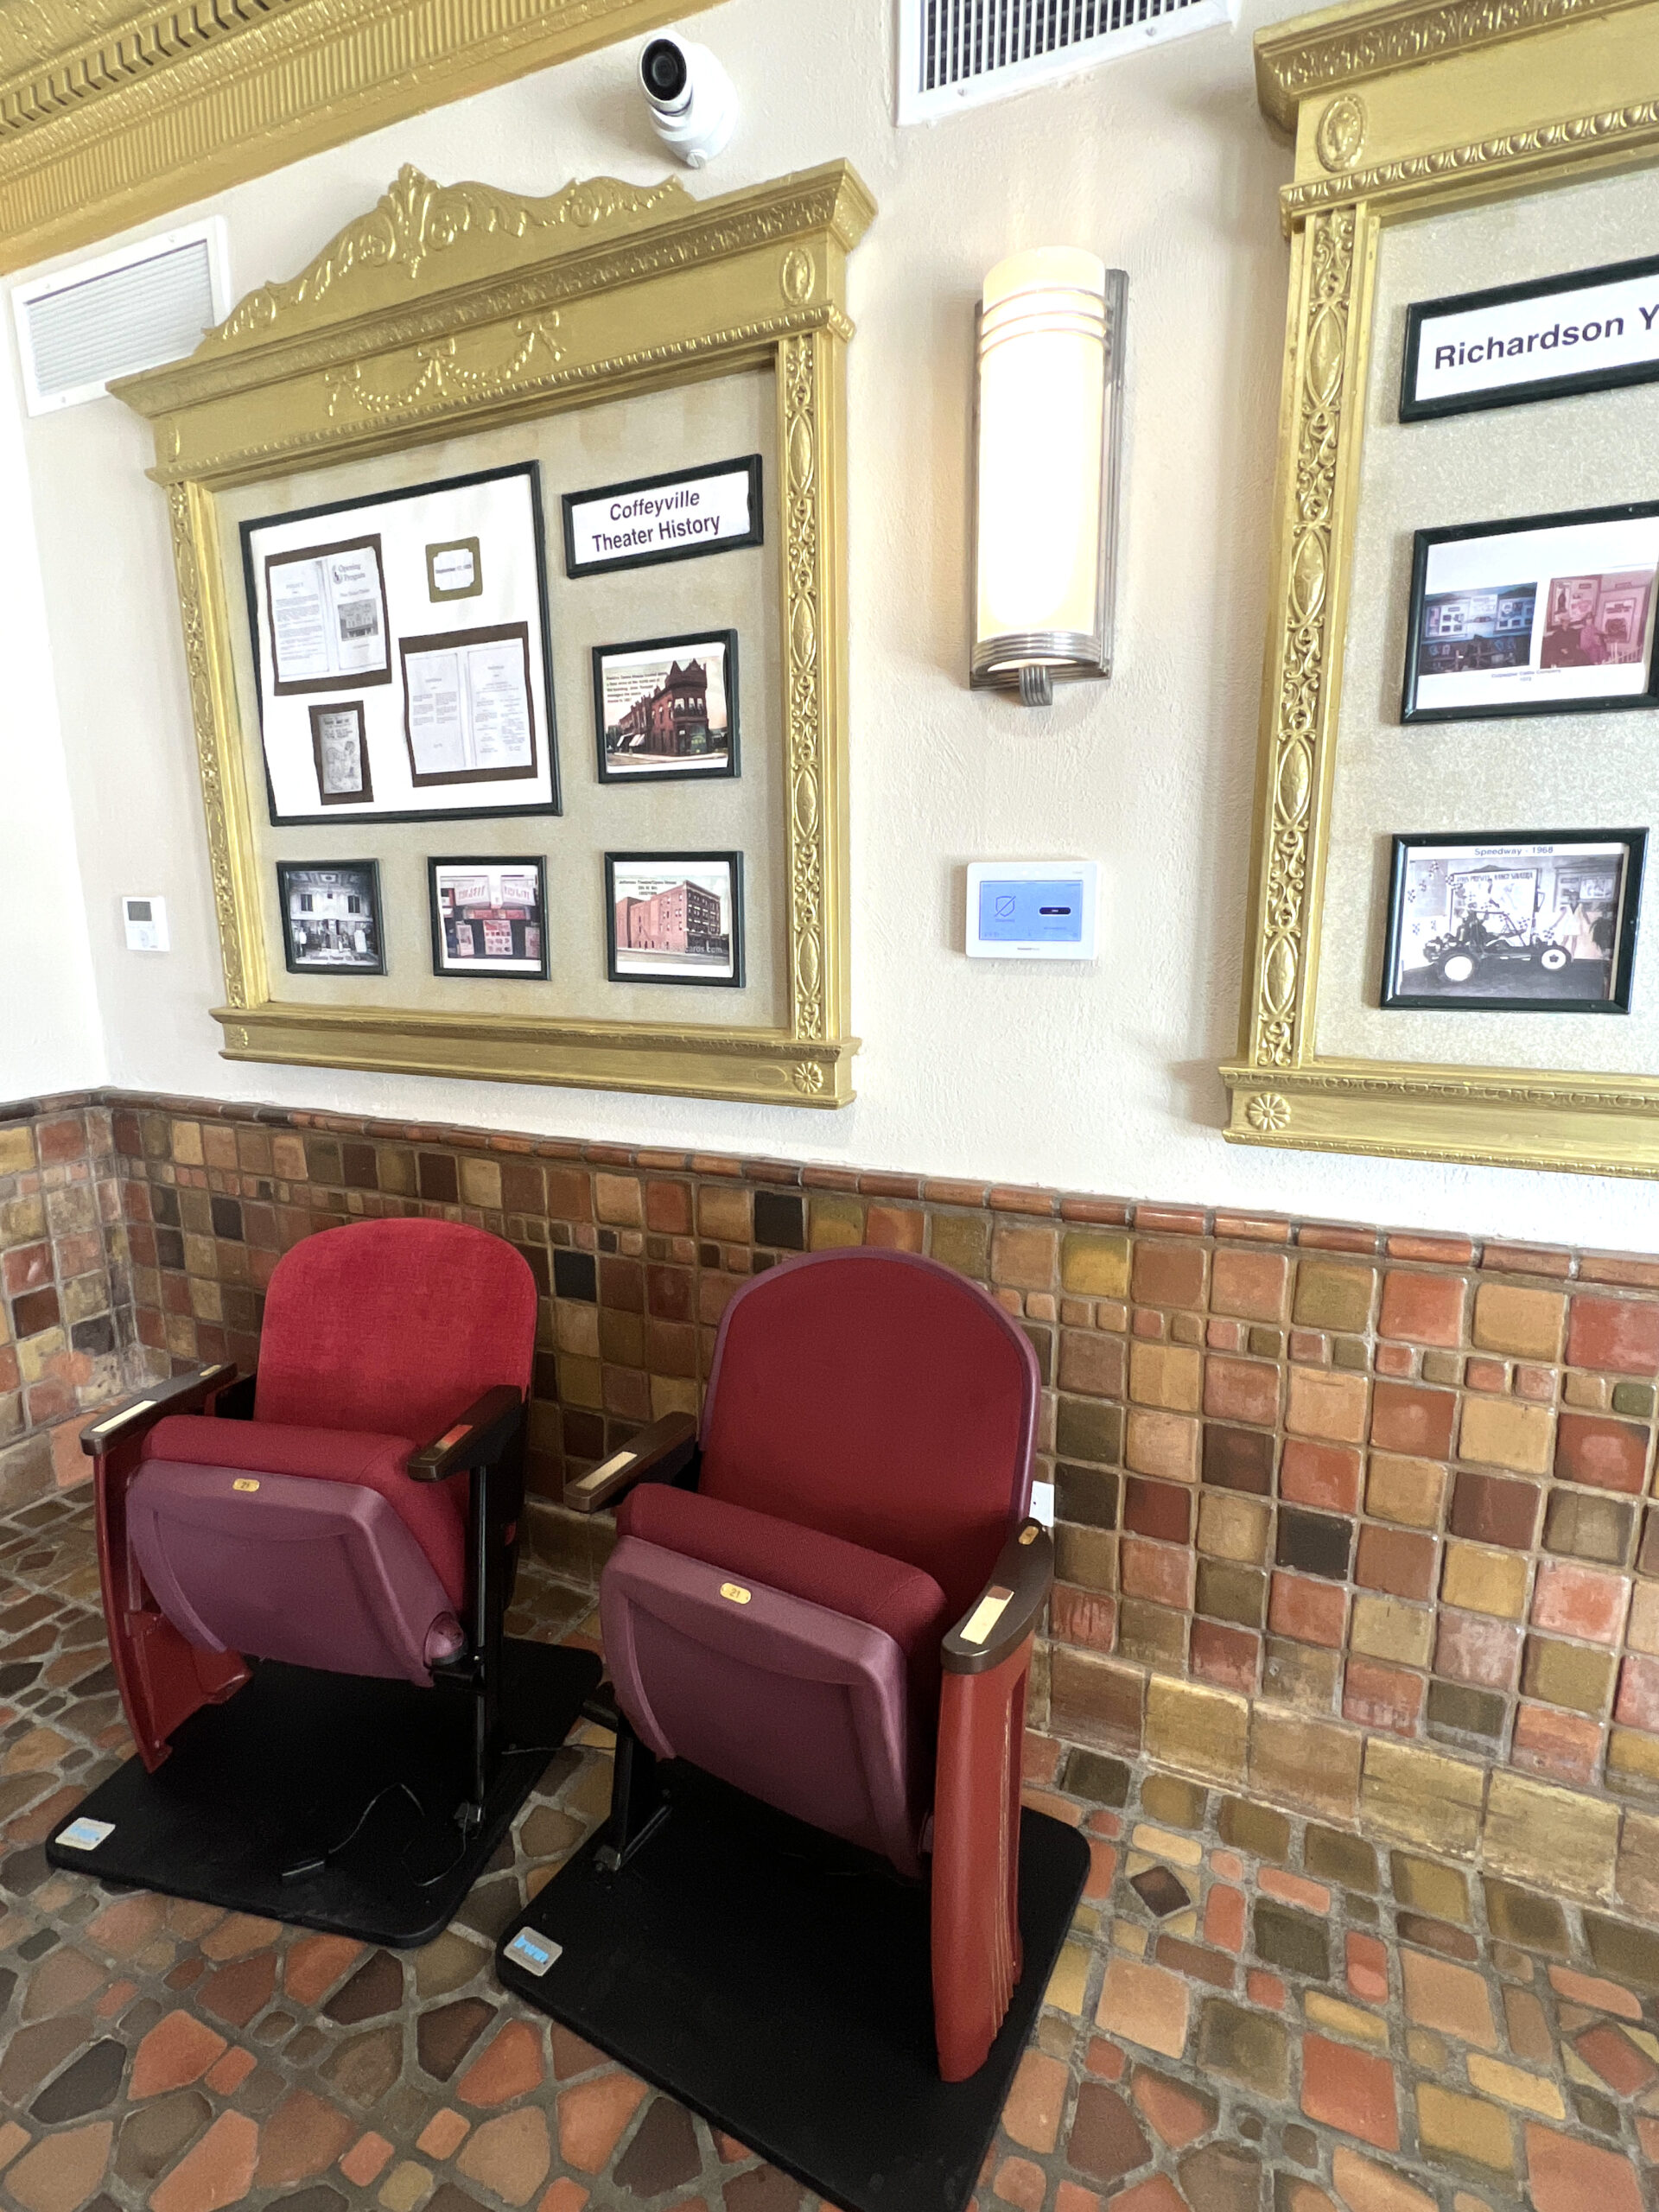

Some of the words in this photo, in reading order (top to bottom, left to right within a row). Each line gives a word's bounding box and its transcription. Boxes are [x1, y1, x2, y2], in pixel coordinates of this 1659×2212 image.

[1434, 316, 1624, 370] Richardson
[610, 490, 700, 521] Coffeyville
[592, 528, 653, 552] Theater
[658, 515, 721, 541] History
[1474, 848, 1522, 856] Speedway
